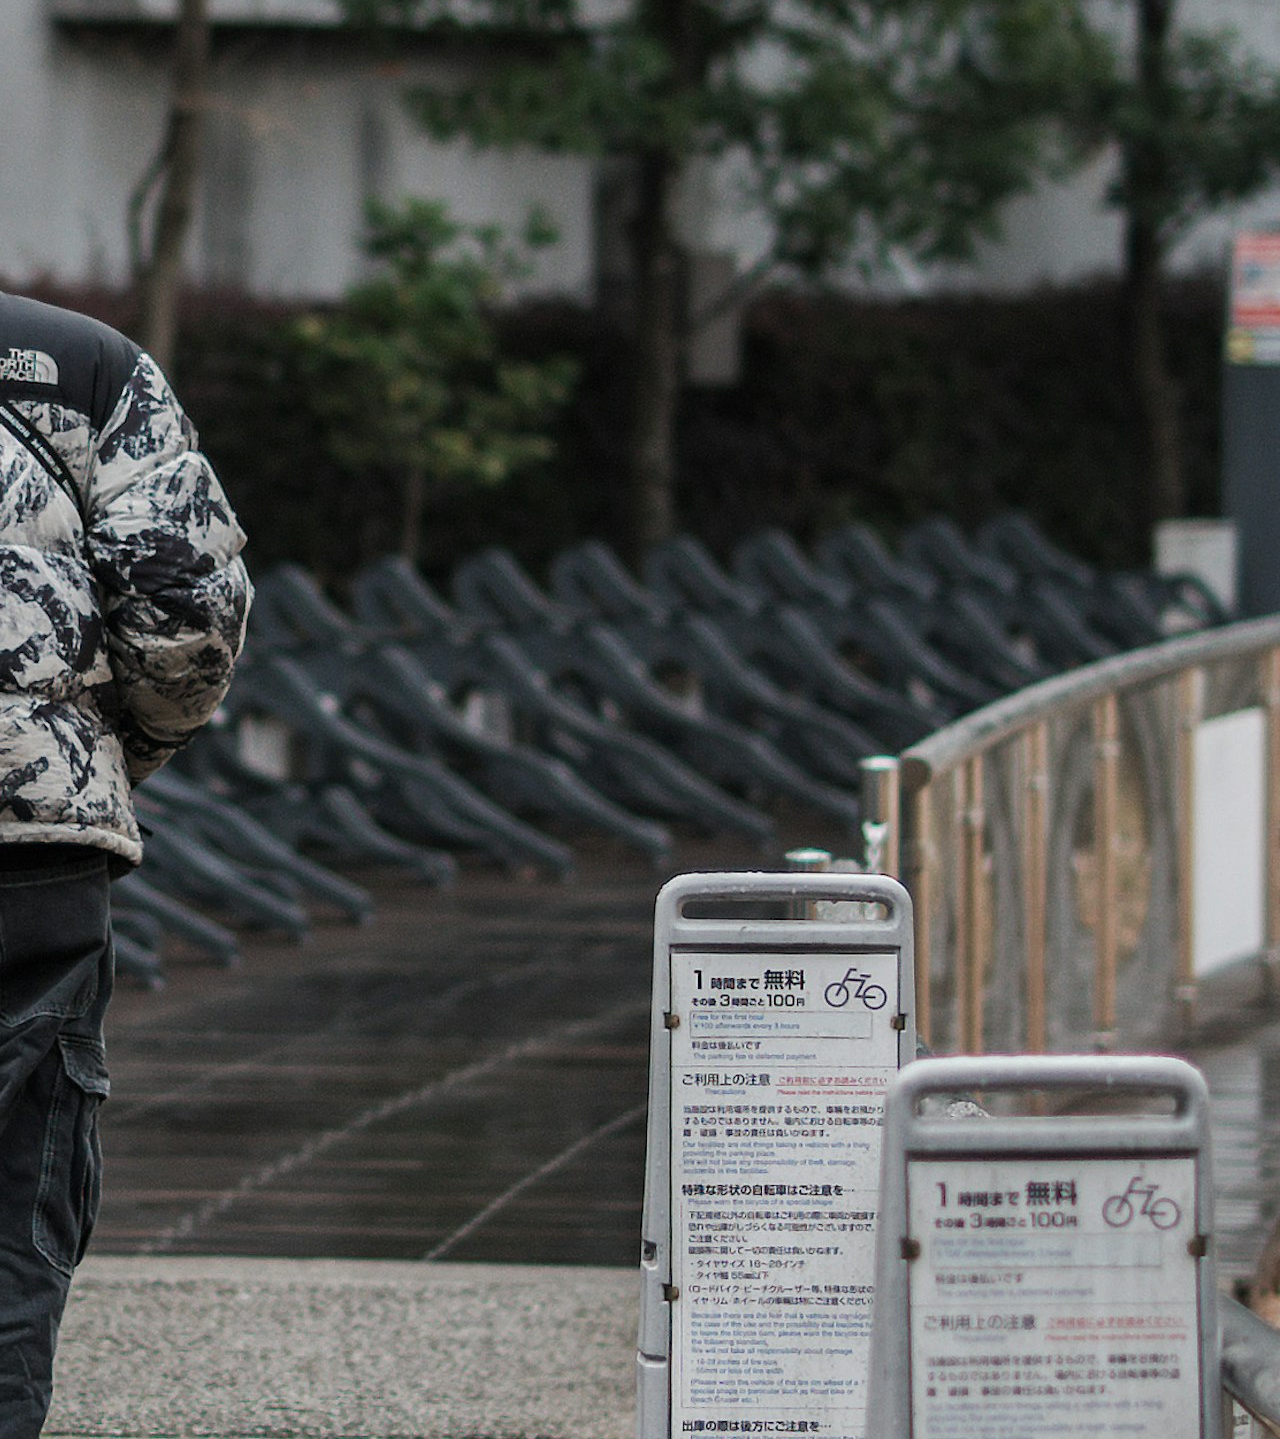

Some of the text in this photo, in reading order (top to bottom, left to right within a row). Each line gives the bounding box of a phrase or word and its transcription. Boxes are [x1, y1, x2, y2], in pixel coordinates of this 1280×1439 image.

[8, 348, 35, 362] THE
[0, 370, 35, 382] FACE
[682, 1073, 771, 1087] ご利用上の注意
[924, 1314, 1037, 1331] ご利用上の注意
